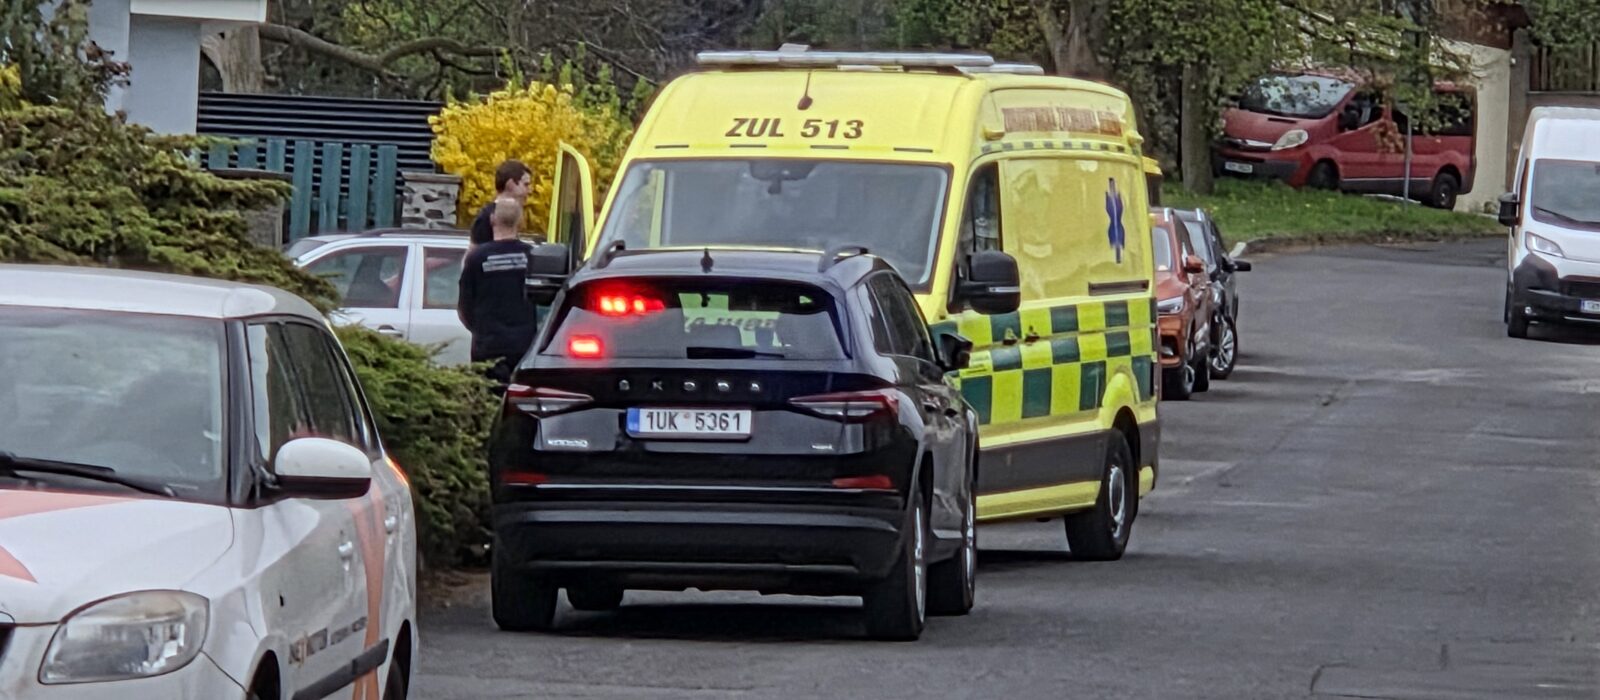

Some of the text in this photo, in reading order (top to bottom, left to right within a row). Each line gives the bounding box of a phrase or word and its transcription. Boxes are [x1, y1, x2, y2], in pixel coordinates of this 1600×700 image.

[725, 118, 864, 139] ZUL 513
[646, 411, 679, 430] 1UK
[695, 412, 741, 431] 5361
